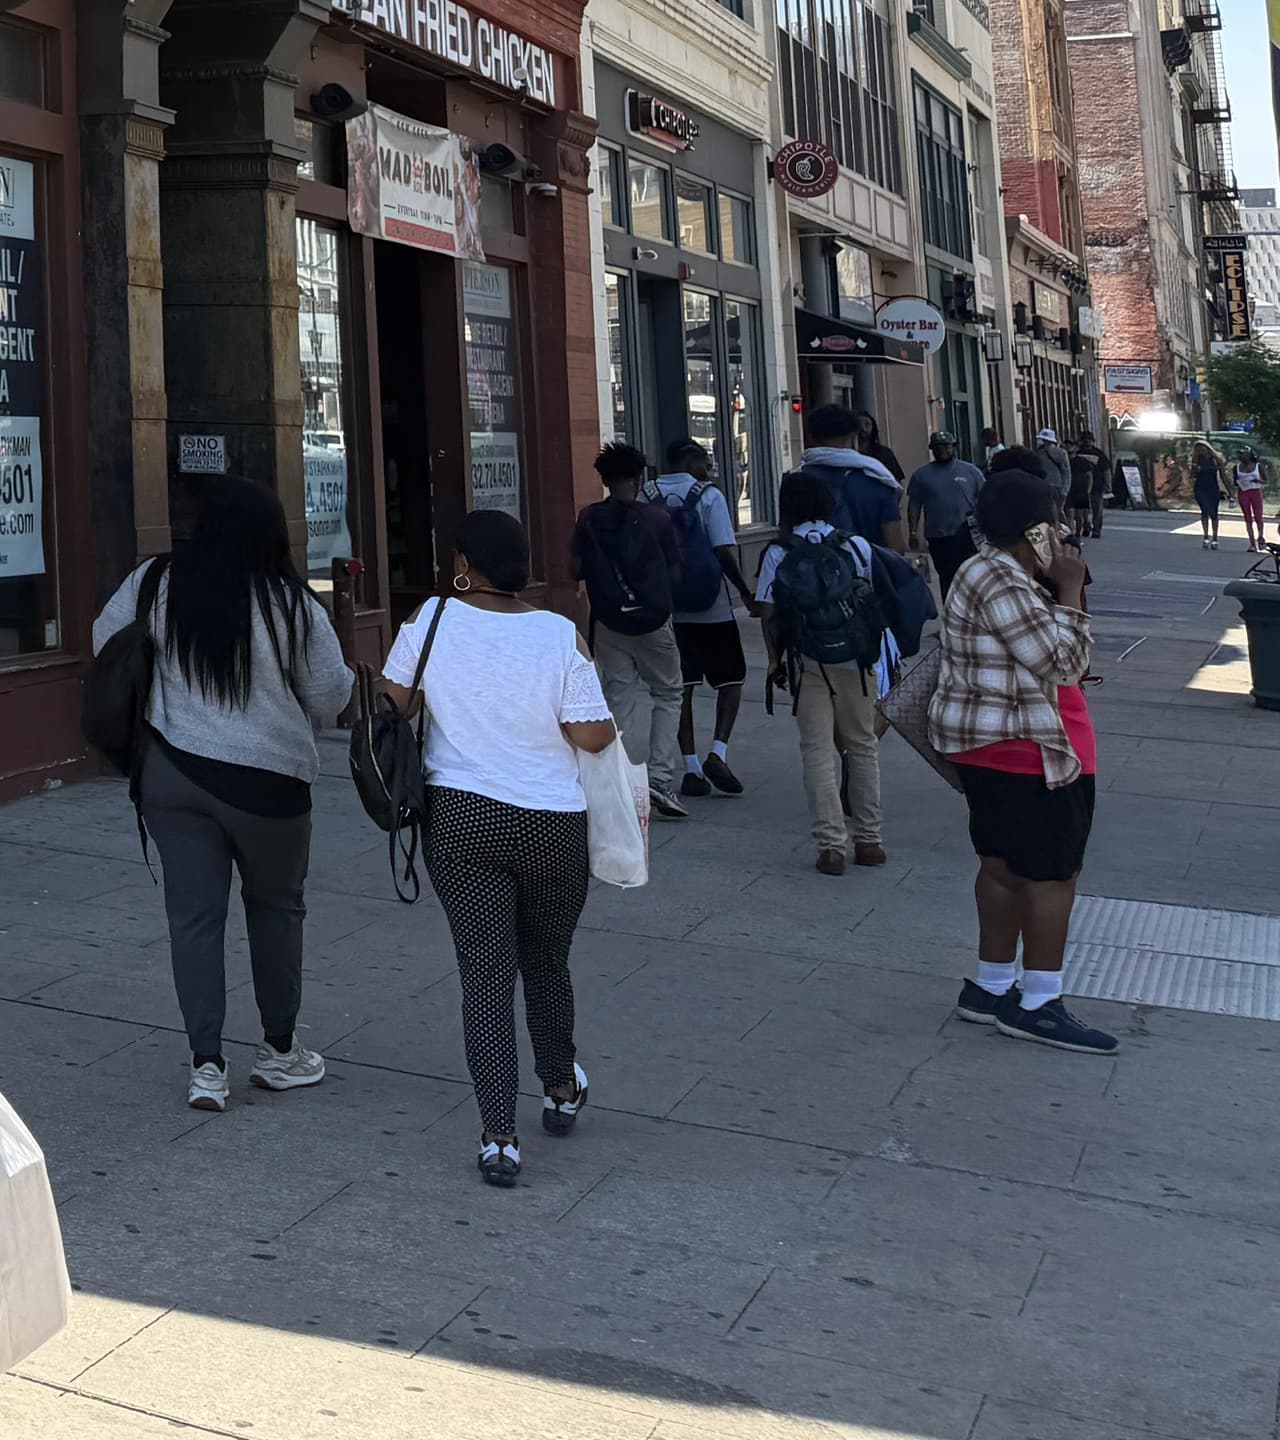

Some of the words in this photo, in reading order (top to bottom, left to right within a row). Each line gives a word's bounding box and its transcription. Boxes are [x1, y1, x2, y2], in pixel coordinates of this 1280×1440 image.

[477, 18, 555, 106] CHICKEN
[778, 142, 833, 164] CHIPOTLE
[379, 146, 411, 186] MAD
[424, 162, 453, 200] BOIL
[1225, 255, 1248, 336] ECLIPSE
[881, 319, 916, 332] Oyster
[919, 319, 938, 330] Bar
[906, 331, 914, 339] &
[197, 438, 217, 450] NO
[183, 449, 222, 459] SMOKING
